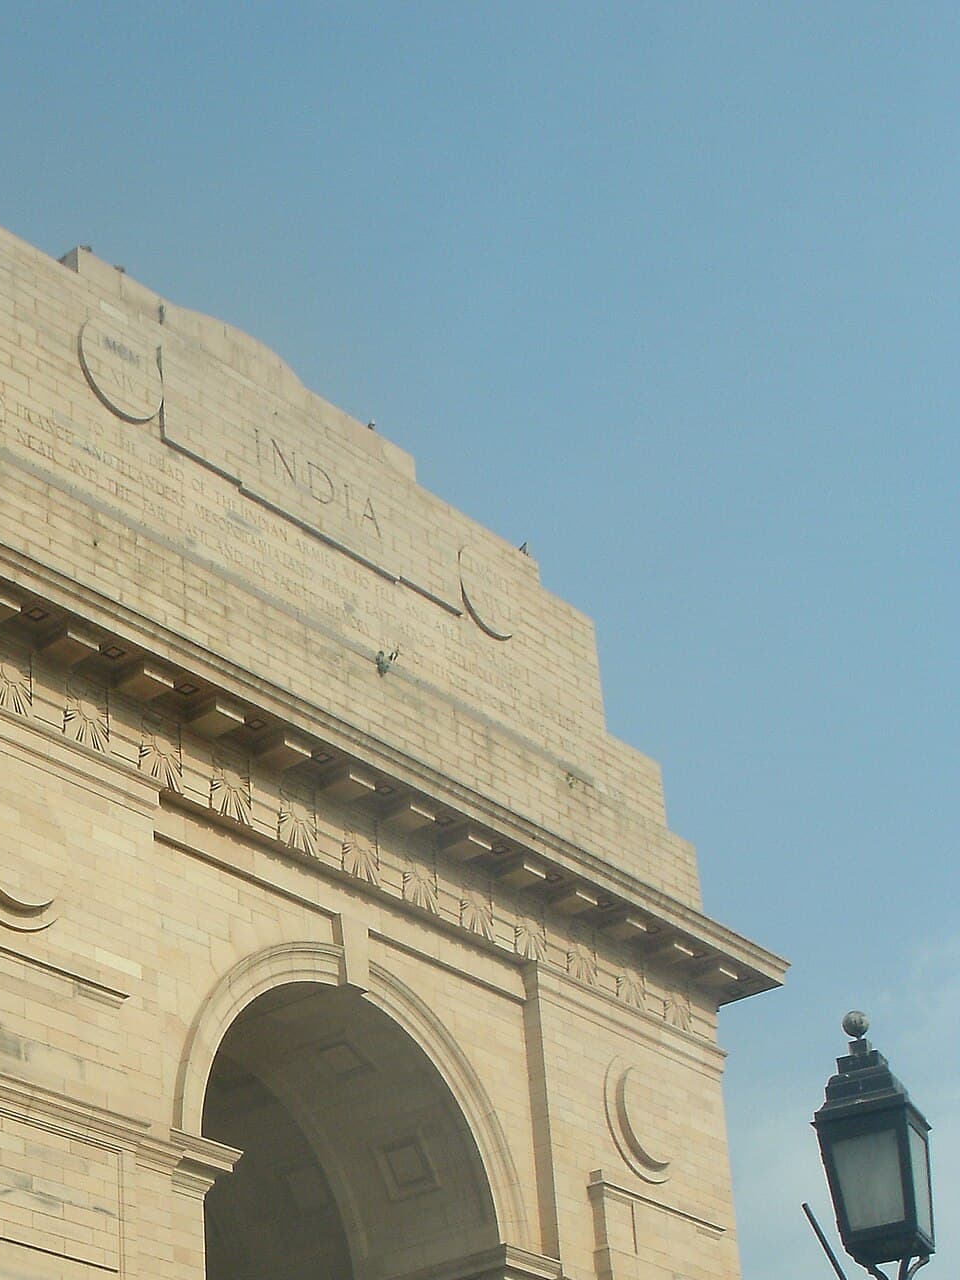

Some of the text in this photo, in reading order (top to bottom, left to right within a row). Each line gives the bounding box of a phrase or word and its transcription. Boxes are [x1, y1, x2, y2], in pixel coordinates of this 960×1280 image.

[15, 427, 57, 462] NEAR
[16, 401, 72, 445] FRANCE
[148, 450, 185, 484] DEAD
[190, 475, 205, 497] OF
[214, 489, 237, 514] THE
[243, 504, 288, 542] INDIAN
[295, 535, 336, 572] ARMIES
[253, 428, 382, 539] INDIA
